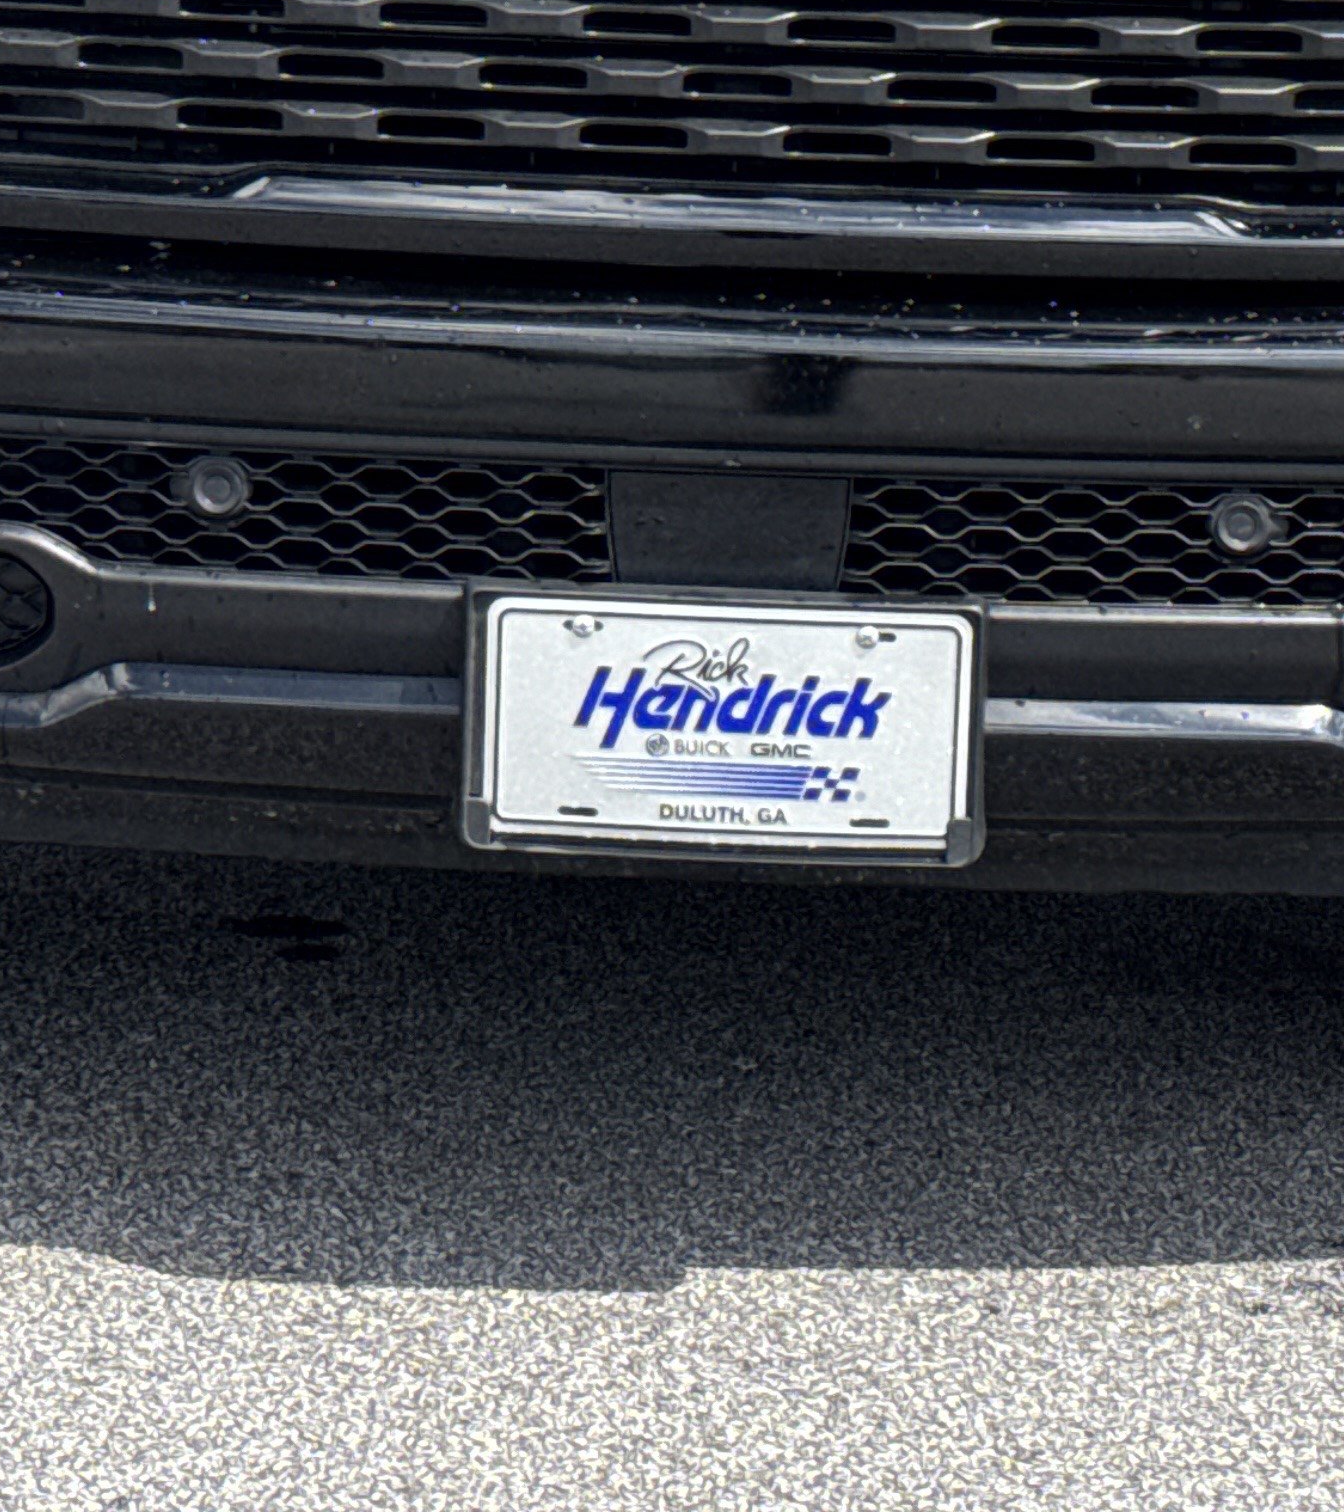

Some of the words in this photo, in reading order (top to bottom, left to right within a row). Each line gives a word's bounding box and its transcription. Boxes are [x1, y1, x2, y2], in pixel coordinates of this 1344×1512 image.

[643, 637, 750, 702] Rick
[573, 665, 893, 749] Hendrick
[674, 739, 731, 758] BUICK
[750, 742, 812, 759] GMC
[659, 802, 751, 826] DULUTH,
[757, 806, 788, 825] GA
